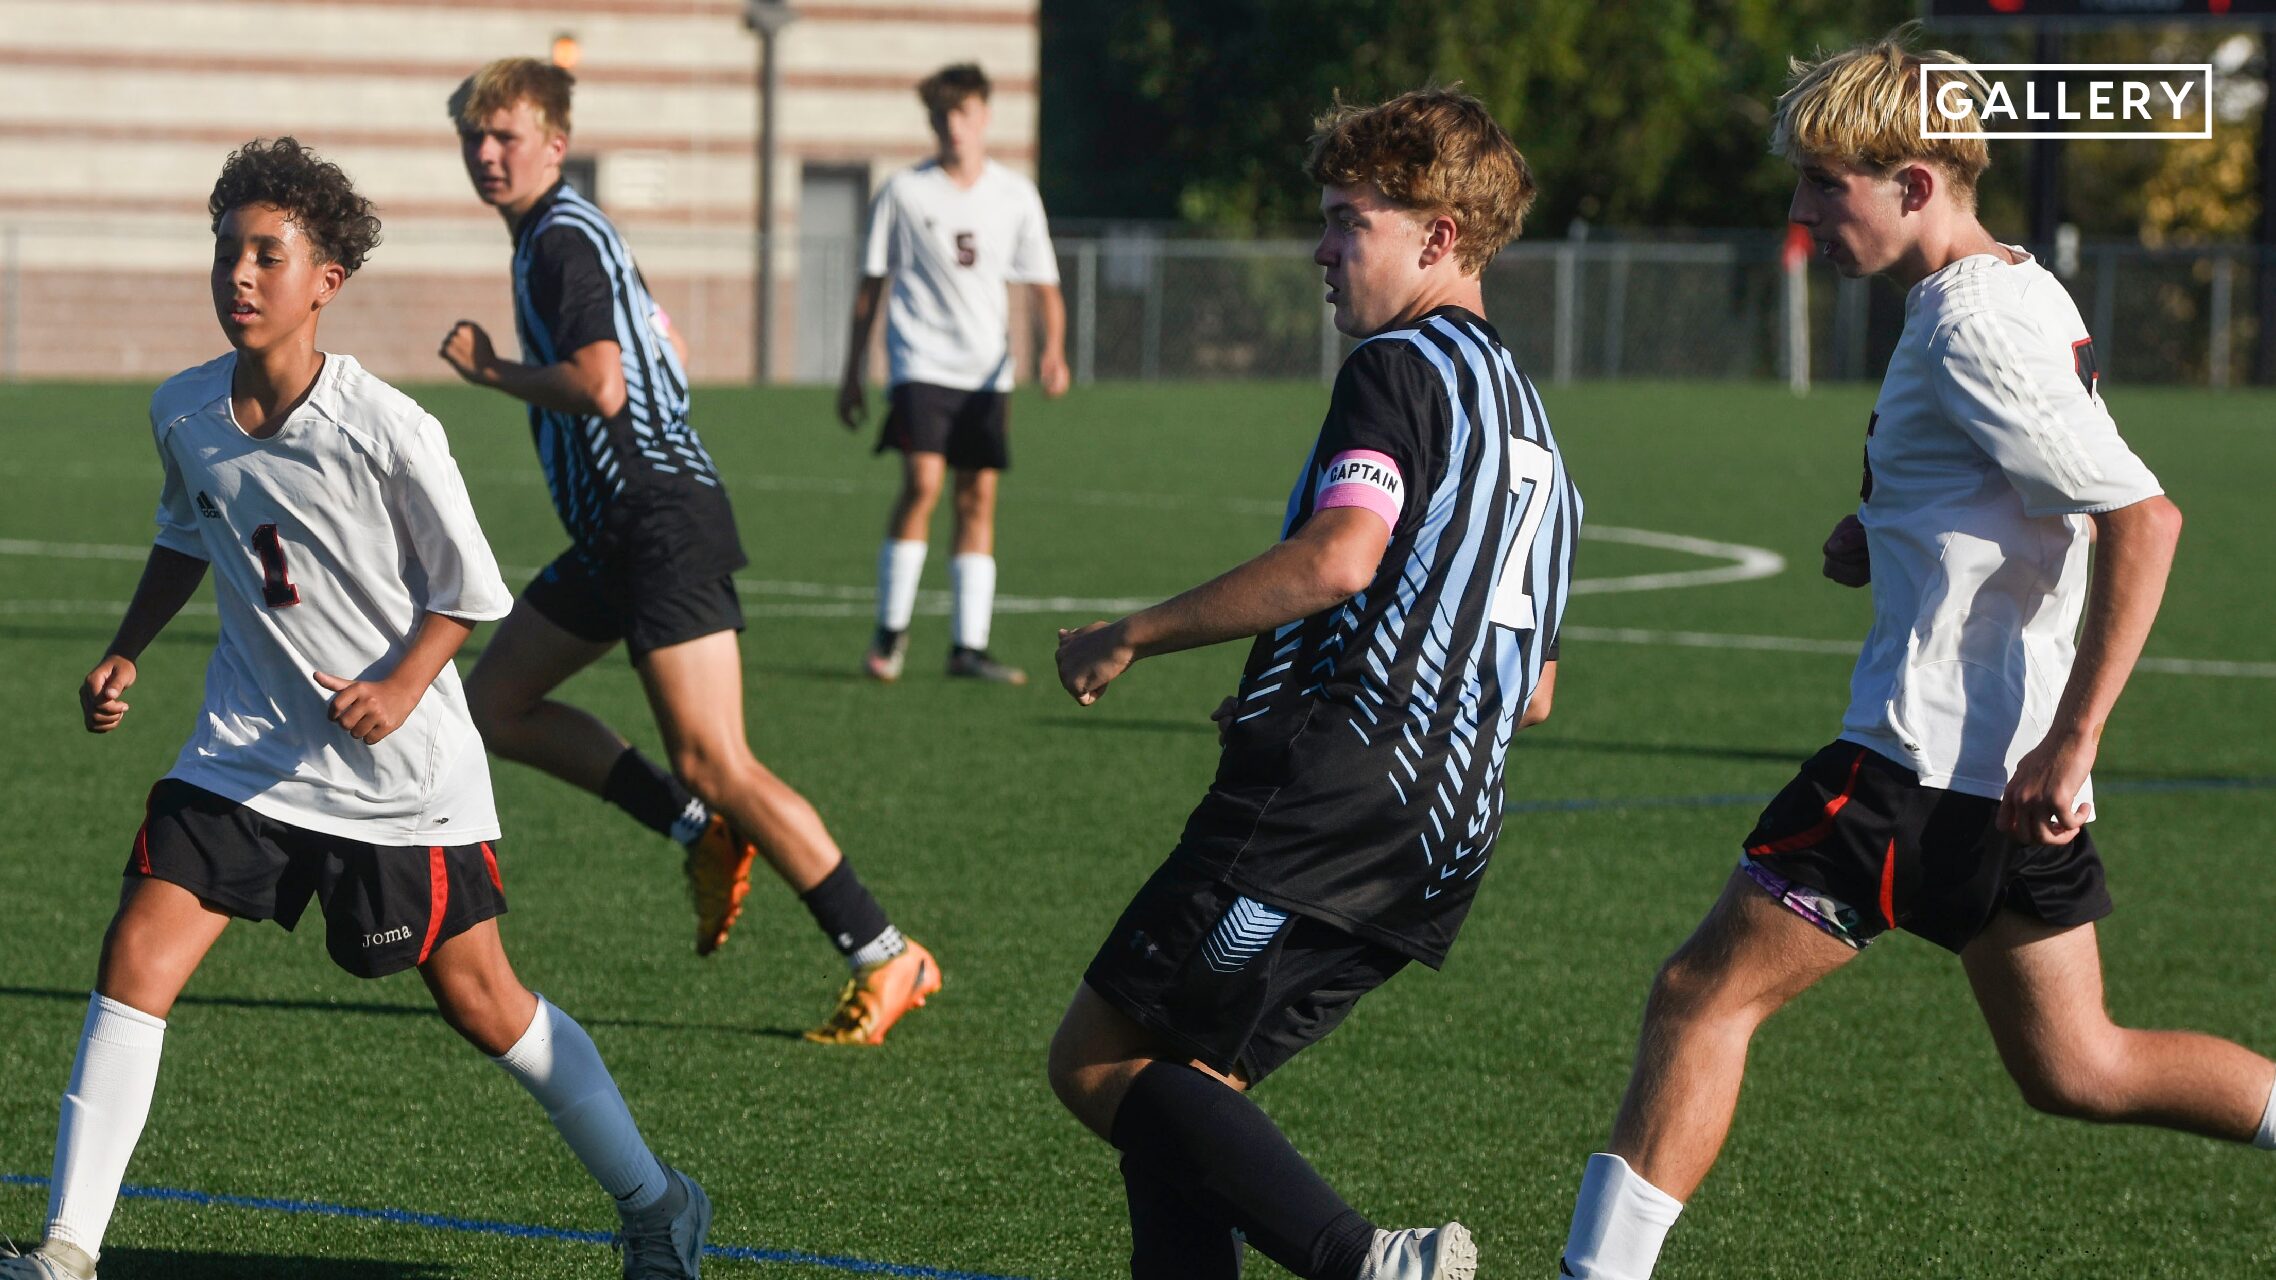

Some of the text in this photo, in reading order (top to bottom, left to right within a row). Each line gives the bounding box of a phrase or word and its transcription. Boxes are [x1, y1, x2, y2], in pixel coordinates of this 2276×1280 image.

[955, 231, 977, 268] 5
[1330, 462, 1399, 494] CAPTAIN
[1489, 432, 1555, 631] 7
[251, 523, 301, 608] 1
[362, 925, 413, 949] Joma
